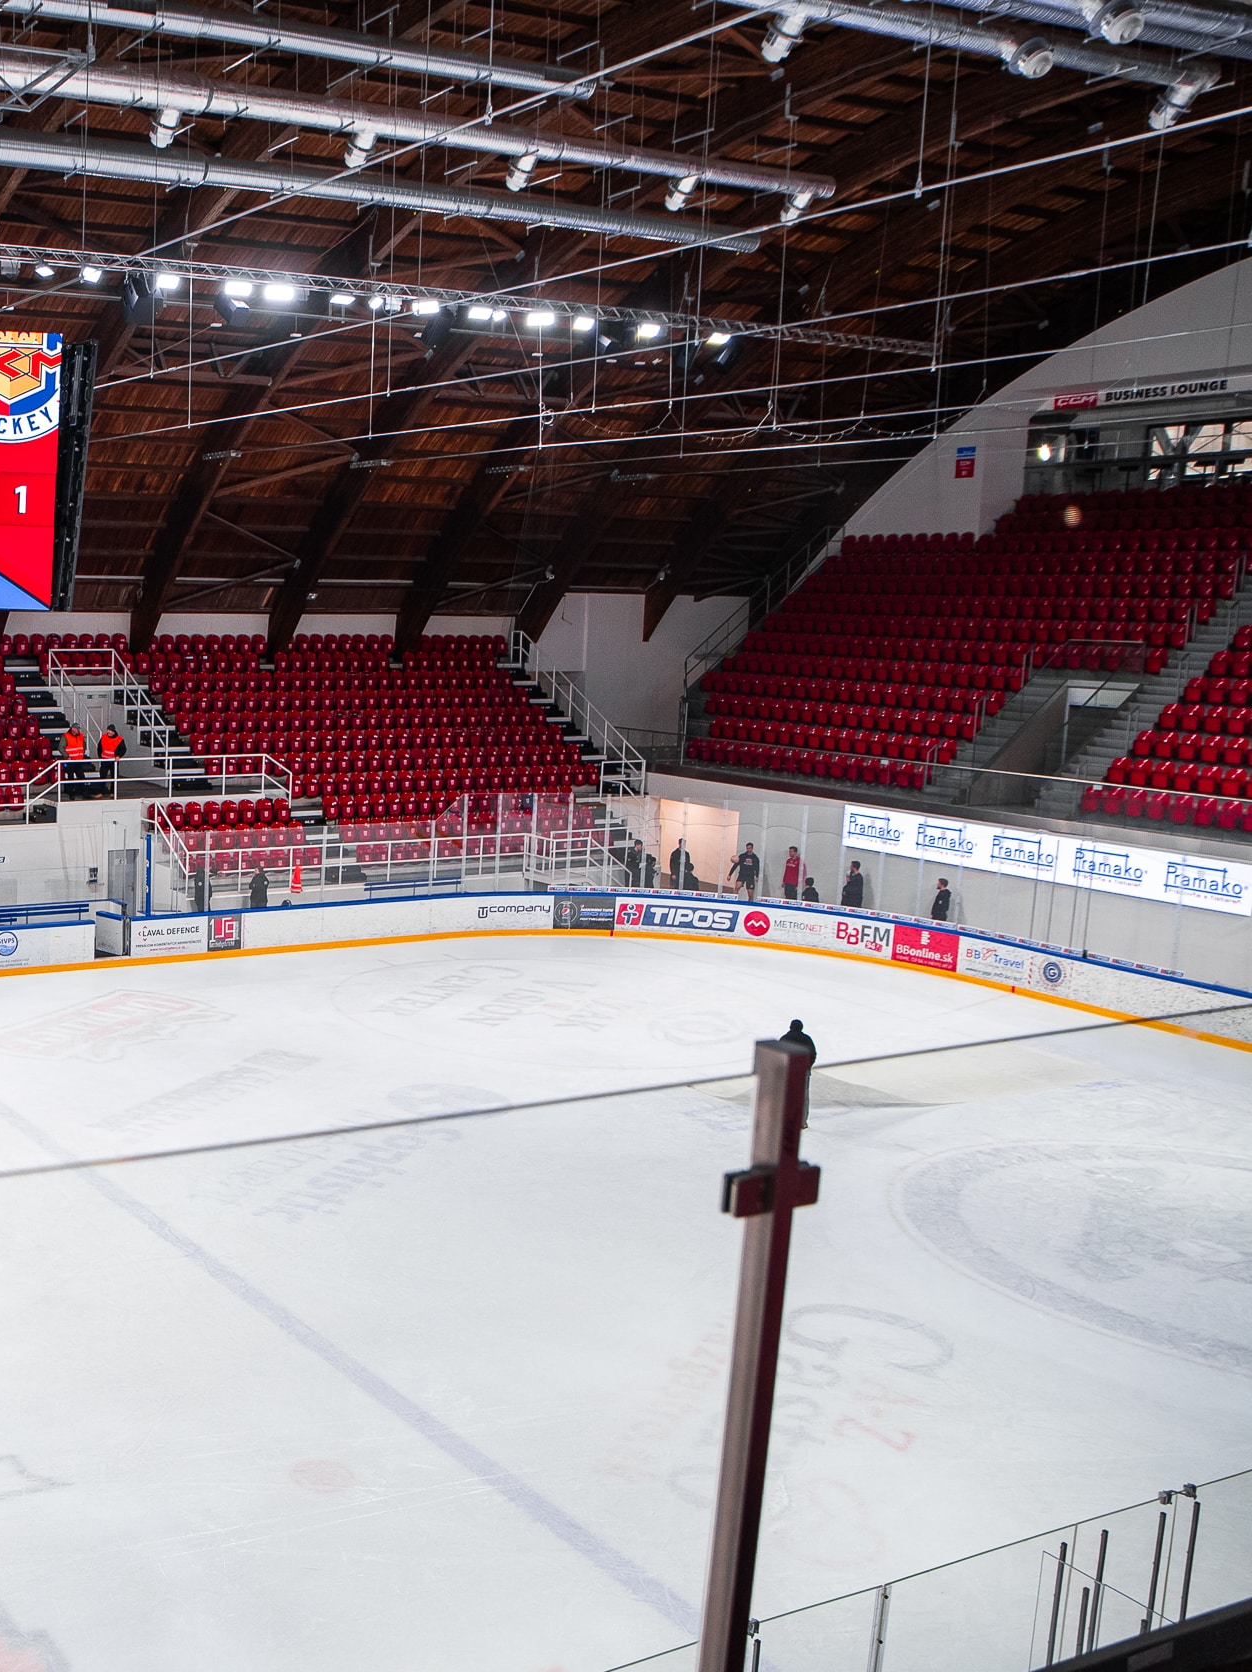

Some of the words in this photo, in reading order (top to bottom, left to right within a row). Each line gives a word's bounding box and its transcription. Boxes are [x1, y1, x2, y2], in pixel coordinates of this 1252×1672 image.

[1057, 394, 1095, 407] CCM
[1105, 386, 1167, 402] BUSINESS
[1171, 379, 1229, 396] LOUNGE
[13, 483, 28, 514] 1
[849, 815, 901, 839] Pramako
[916, 826, 974, 851] Pramako
[992, 838, 1054, 864] Pramako
[1075, 850, 1143, 879] Pramako
[1165, 864, 1243, 895] Pramako
[649, 906, 733, 929] TIPOS
[774, 920, 823, 933] METRONET
[167, 926, 200, 935] DEFENCE
